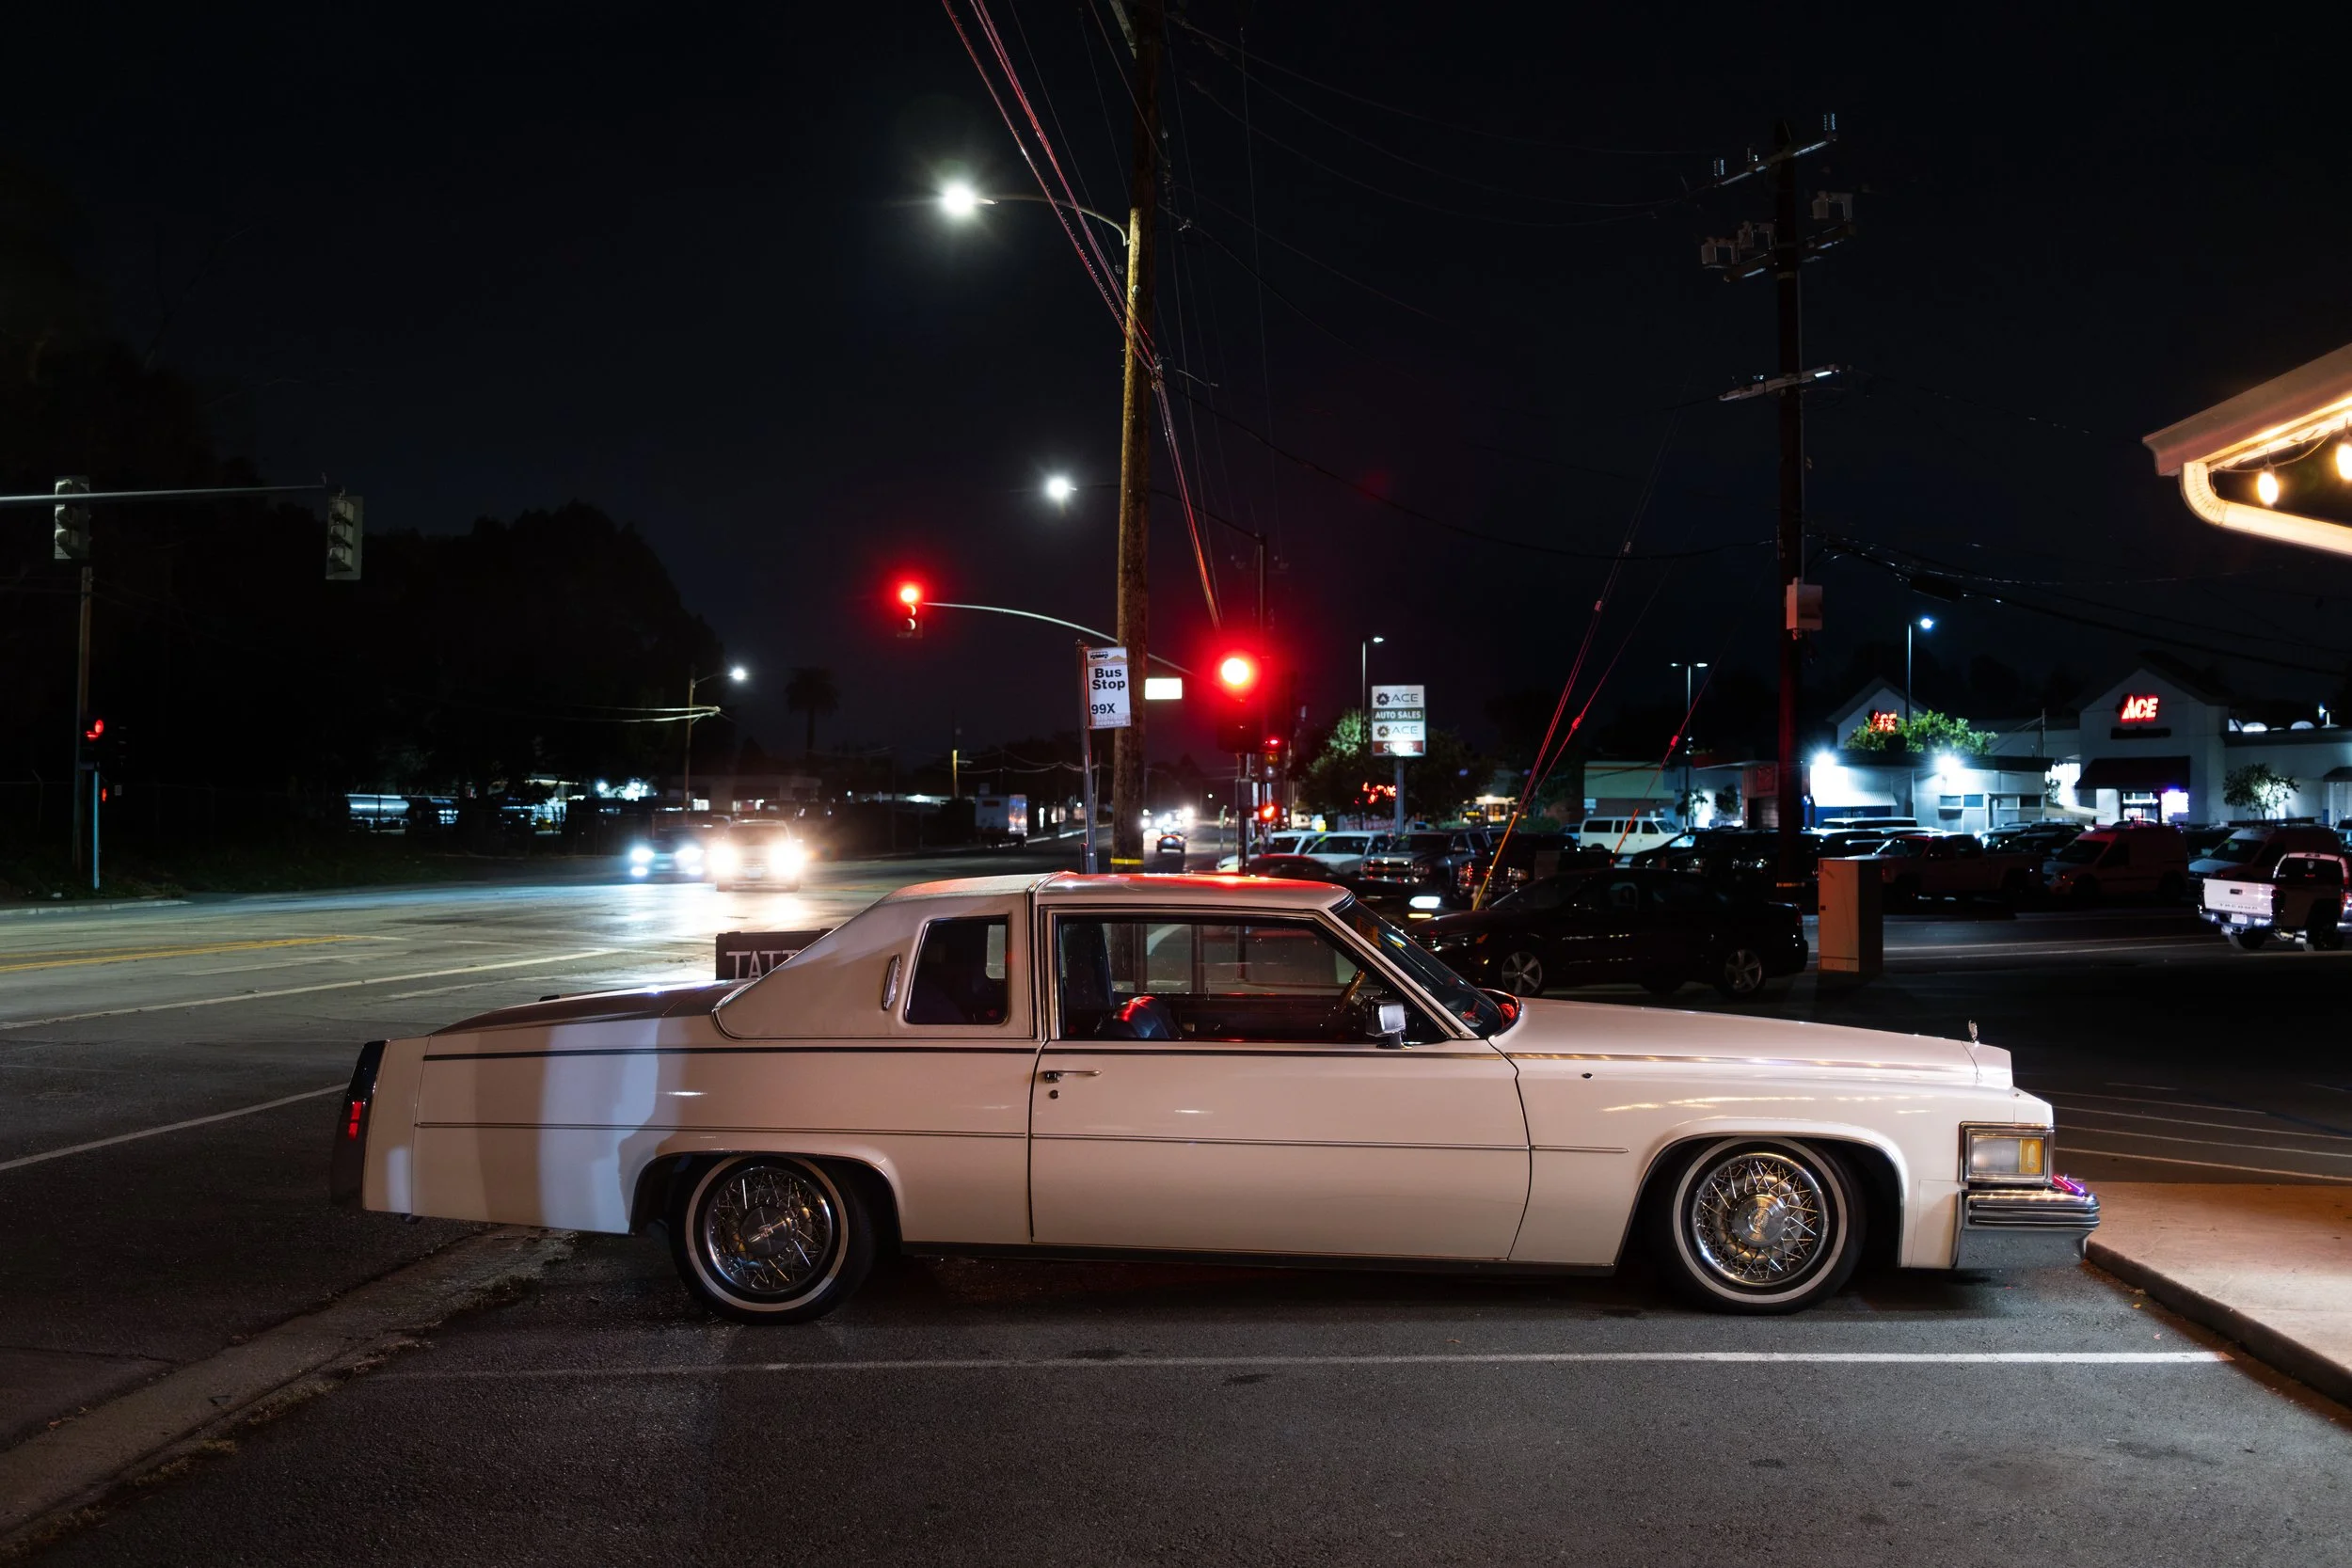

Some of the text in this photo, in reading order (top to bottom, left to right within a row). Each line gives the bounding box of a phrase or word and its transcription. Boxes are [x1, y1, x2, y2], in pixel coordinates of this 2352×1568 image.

[1094, 668, 1122, 678] Bus
[1092, 679, 1126, 690] Stop
[1391, 693, 1419, 703] ACE
[1091, 703, 1116, 715] 99X
[2122, 695, 2158, 720] ACE
[1375, 710, 1422, 720] AUTO SALES
[1391, 725, 1419, 735] ACE
